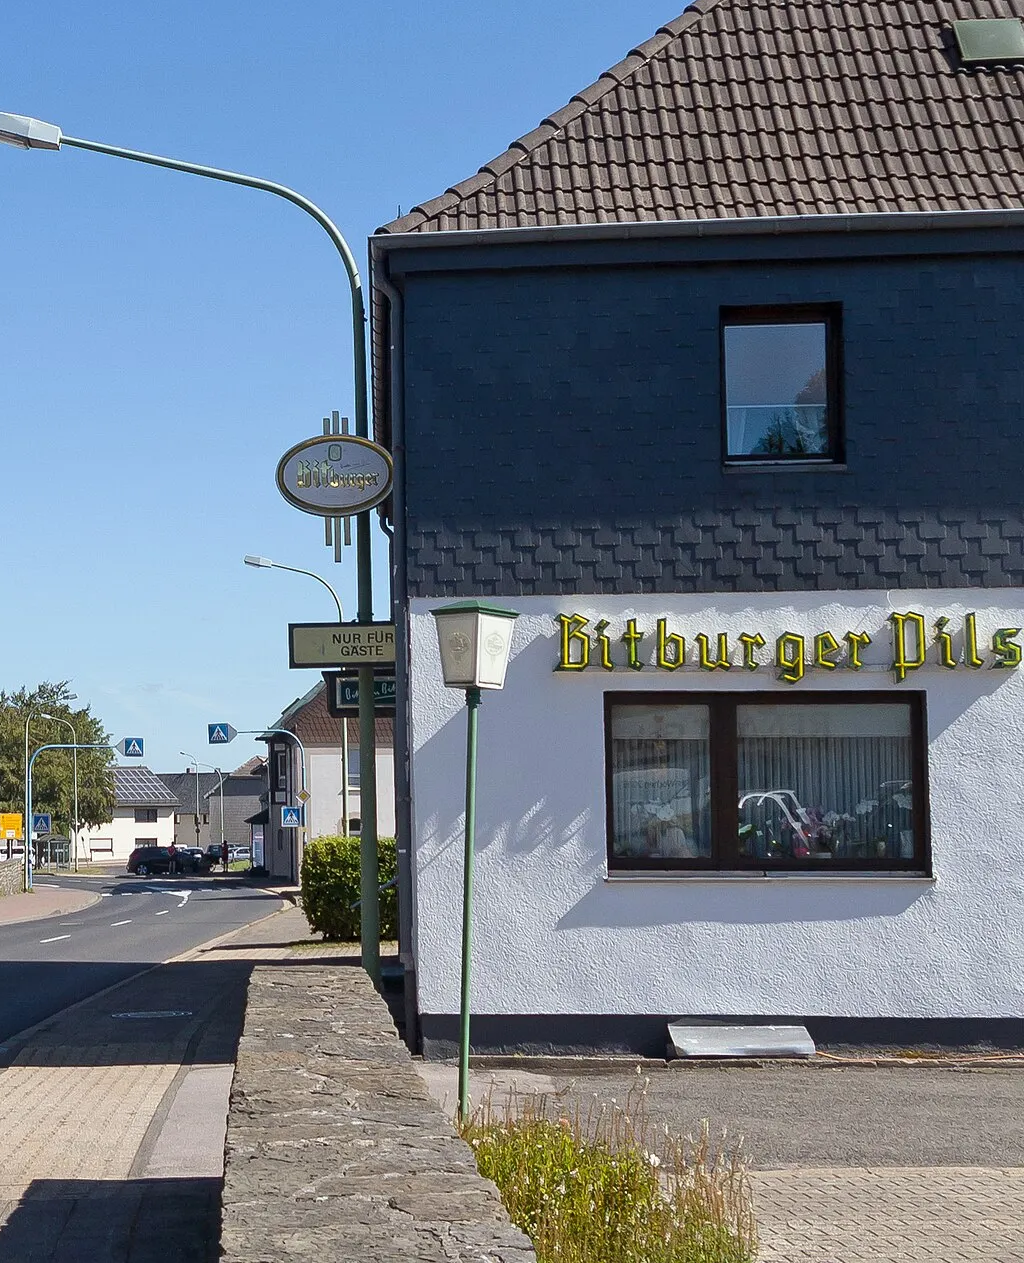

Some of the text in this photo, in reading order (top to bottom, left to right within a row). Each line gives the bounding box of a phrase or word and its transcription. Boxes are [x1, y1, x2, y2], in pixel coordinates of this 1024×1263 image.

[296, 459, 379, 492] Bitburger
[332, 630, 394, 645] NUR FÜR
[553, 611, 1023, 684] Bitburger Pils
[340, 644, 384, 656] GÄSTE
